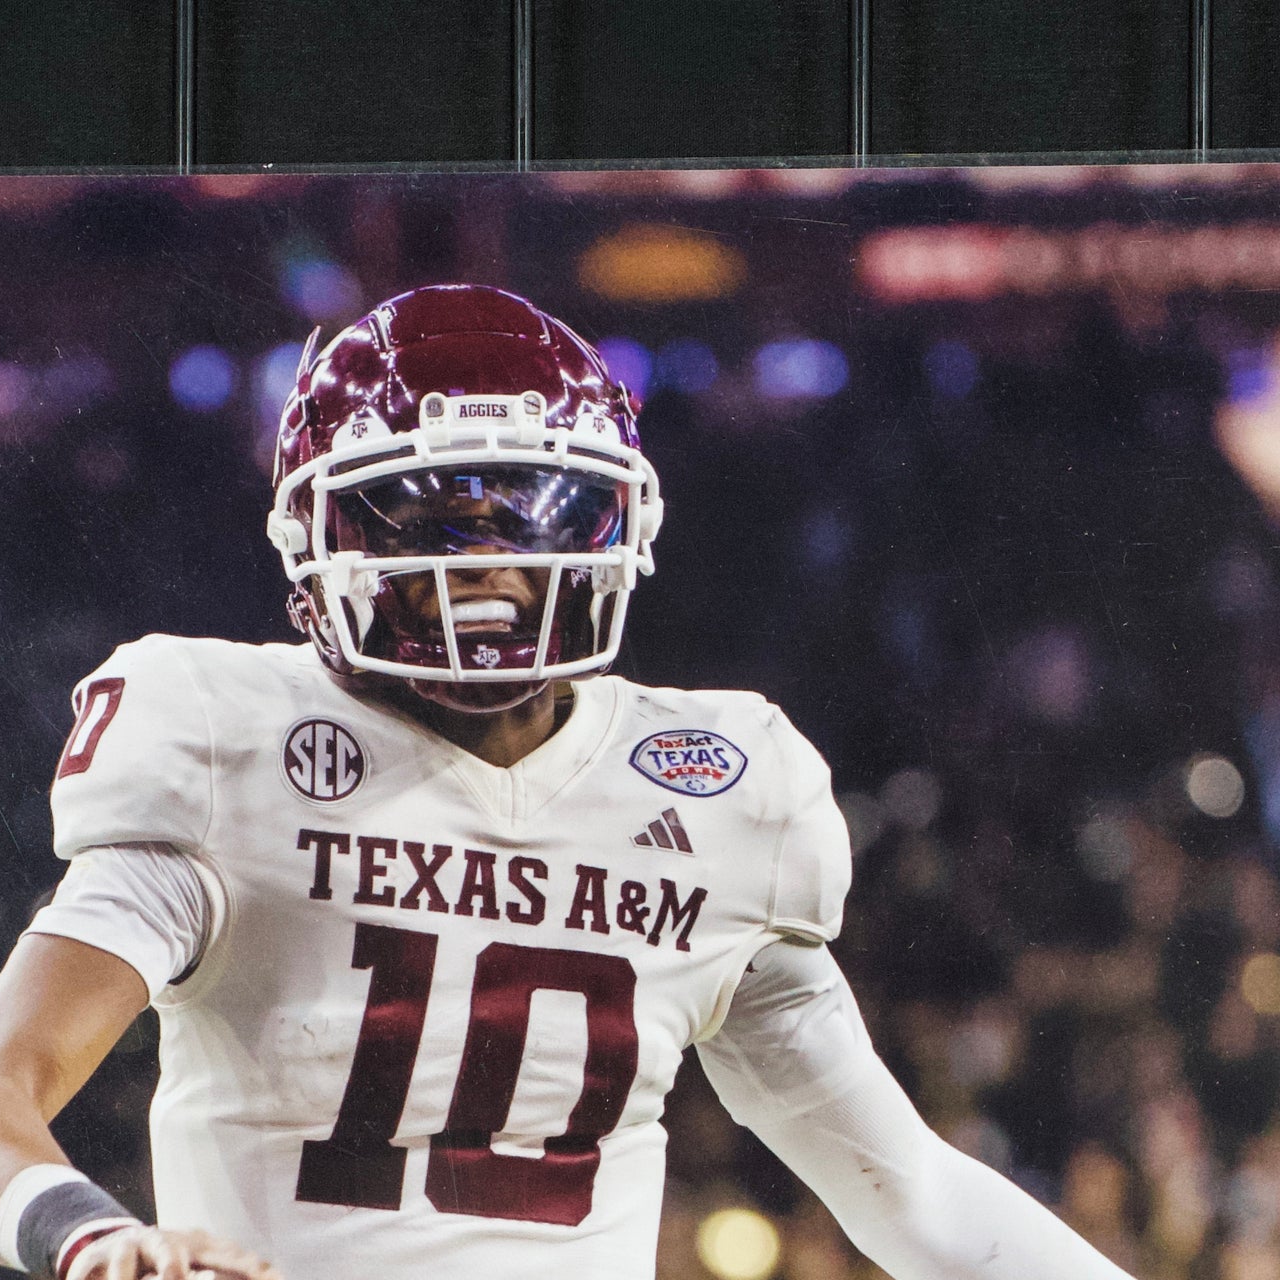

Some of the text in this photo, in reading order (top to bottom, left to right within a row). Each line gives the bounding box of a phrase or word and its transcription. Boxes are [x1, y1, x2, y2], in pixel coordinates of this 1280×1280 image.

[459, 404, 508, 418] AGGIES
[289, 723, 358, 798] SEC
[647, 747, 730, 771] TEXAS
[653, 736, 713, 749] TaxAct
[296, 829, 708, 952] TEXAS A&M
[295, 922, 639, 1227] 10
